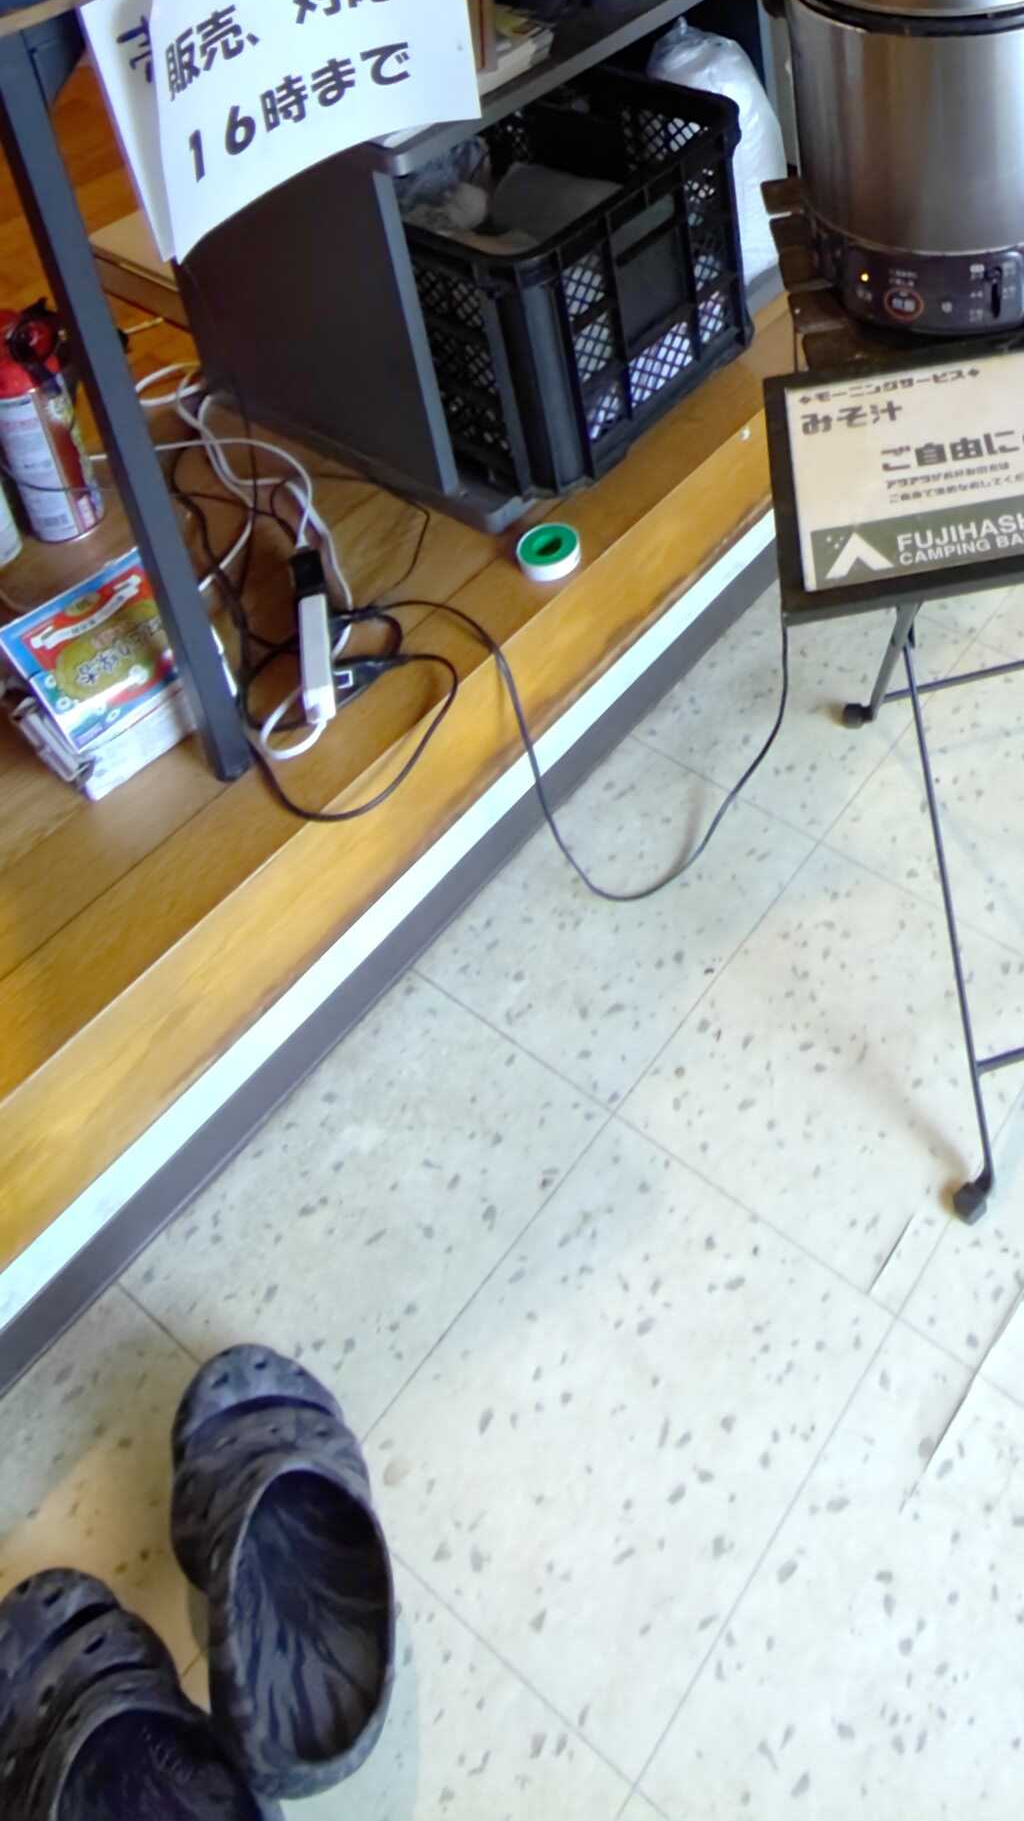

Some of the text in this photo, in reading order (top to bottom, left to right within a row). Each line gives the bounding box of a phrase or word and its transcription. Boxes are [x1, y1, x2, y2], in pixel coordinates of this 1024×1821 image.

[801, 399, 903, 436] みそ汁
[898, 540, 992, 567] CAMPING
